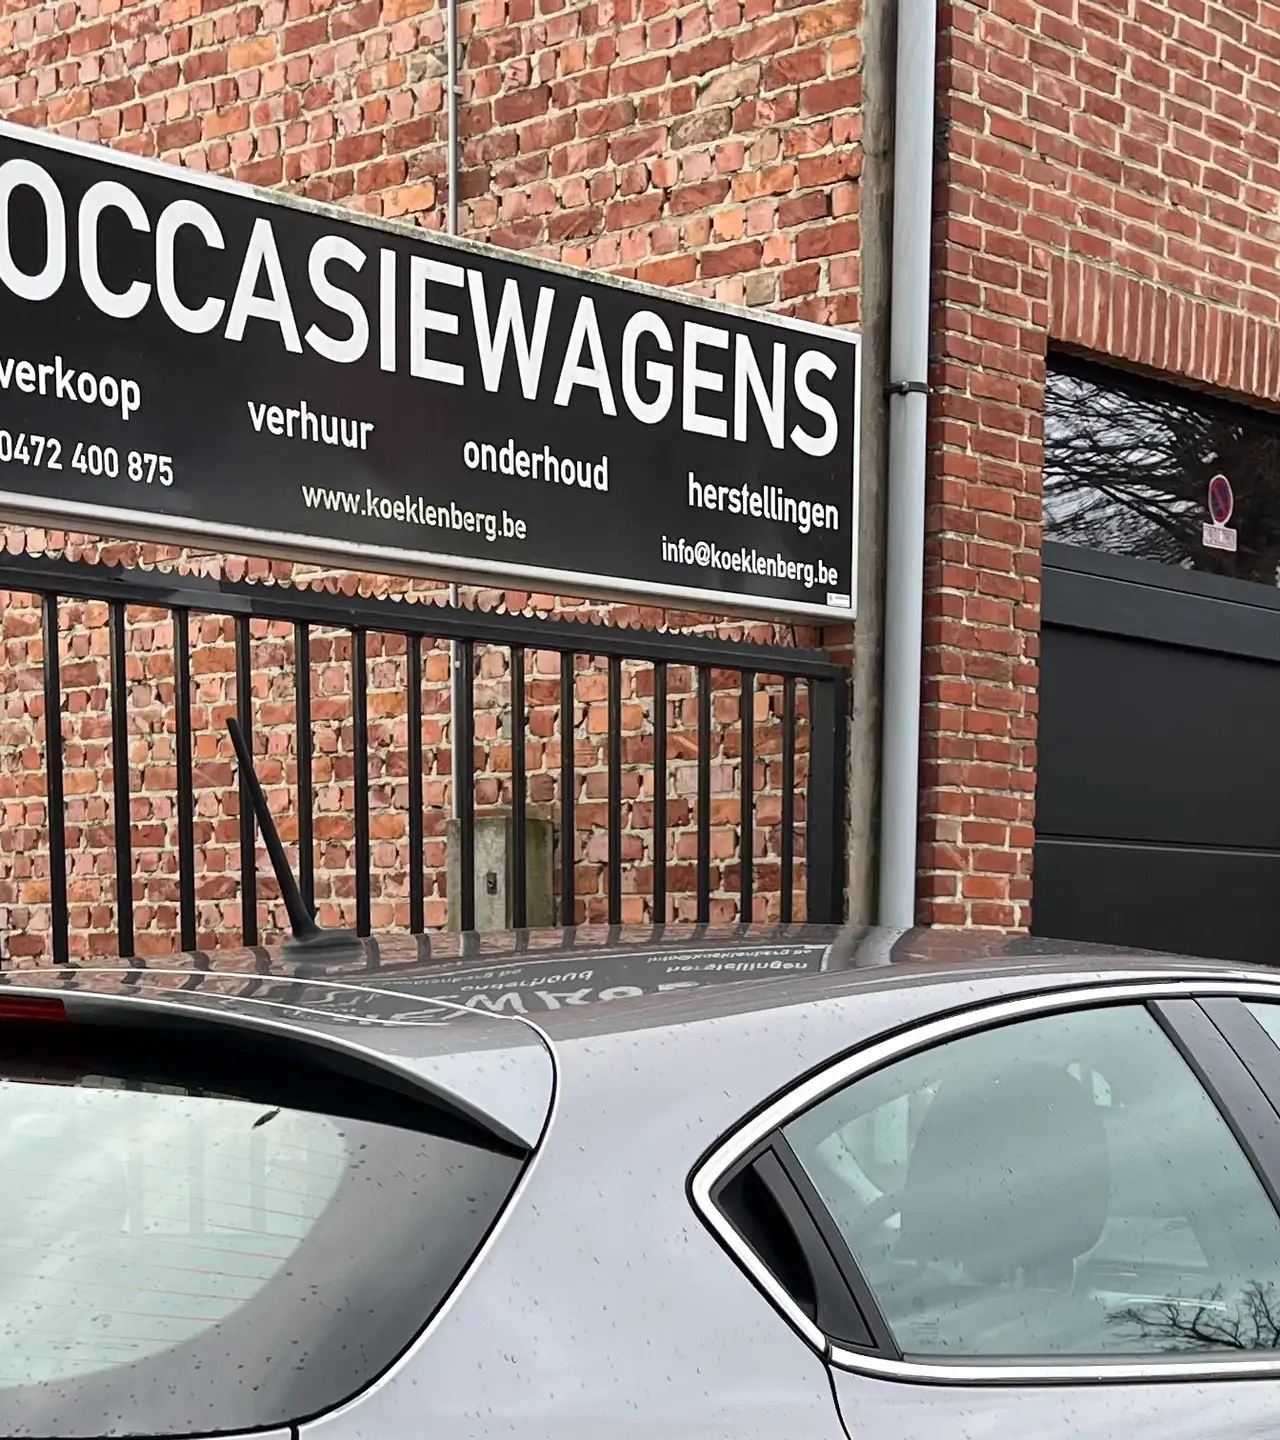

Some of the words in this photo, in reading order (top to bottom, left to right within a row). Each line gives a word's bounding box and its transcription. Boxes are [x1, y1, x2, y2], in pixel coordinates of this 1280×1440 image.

[71, 442, 119, 478] 400
[127, 450, 174, 487] 875
[247, 400, 375, 450] verhuur
[463, 438, 609, 492] onderhoud
[688, 471, 839, 534] herstellingen
[302, 484, 527, 541] www.koeklenberg.be
[661, 535, 839, 589] info@koeklenberg.be
